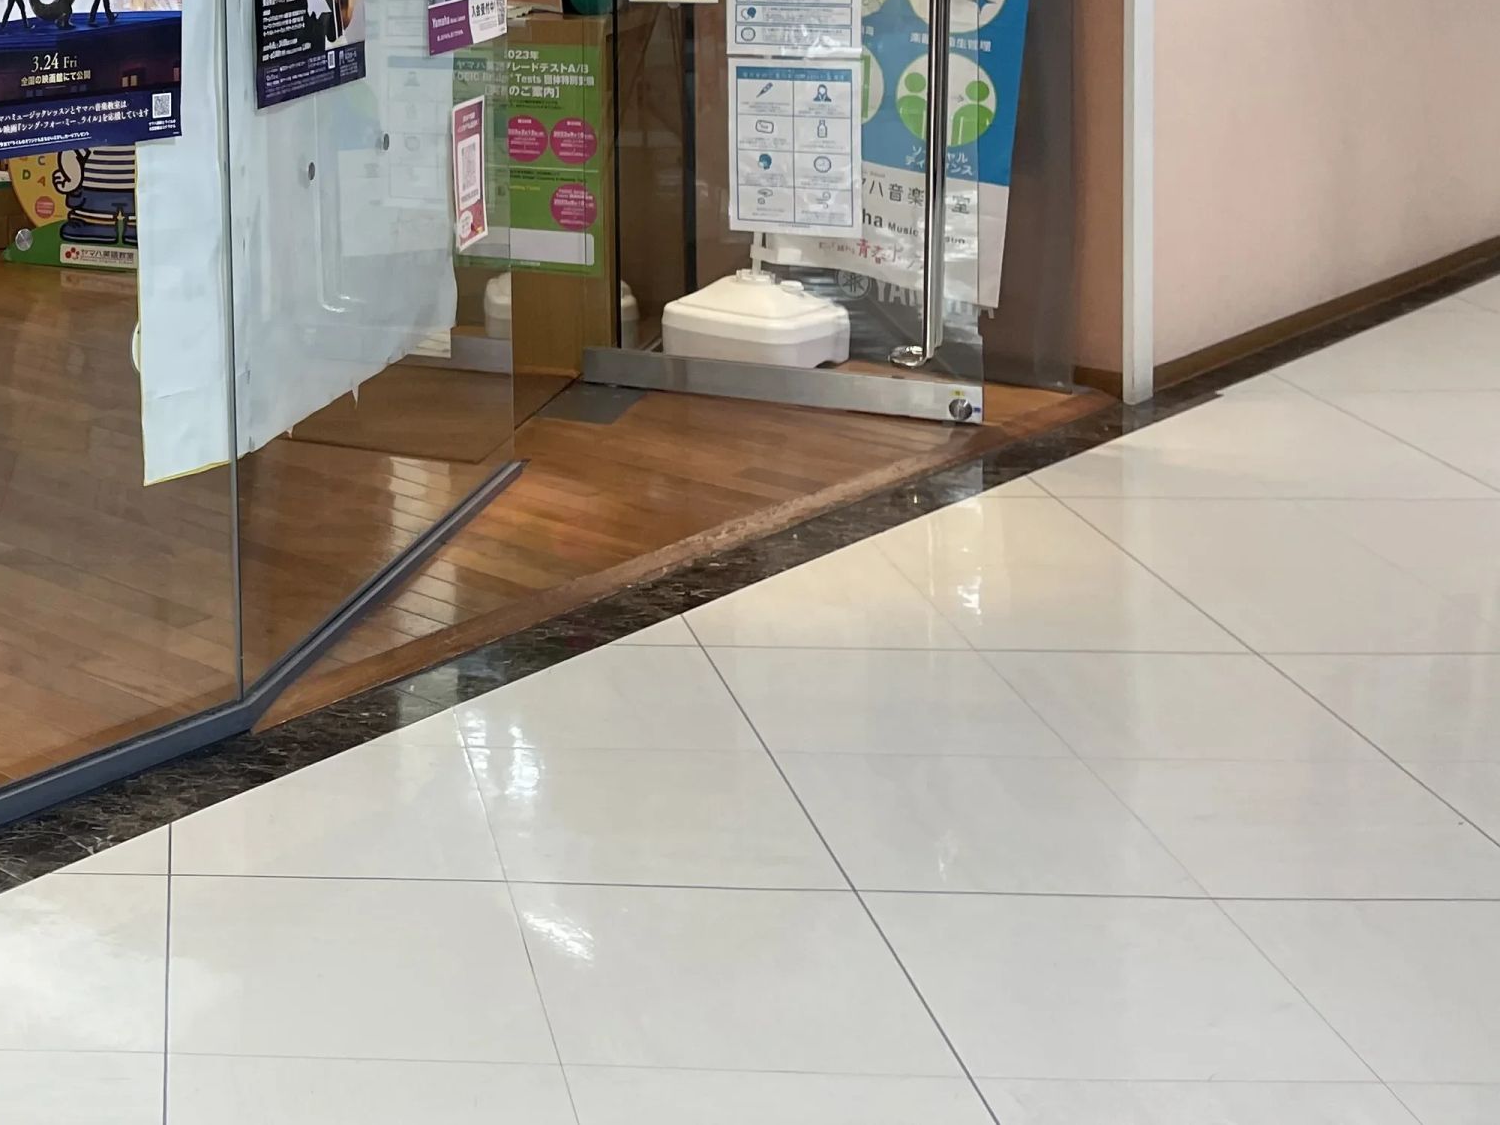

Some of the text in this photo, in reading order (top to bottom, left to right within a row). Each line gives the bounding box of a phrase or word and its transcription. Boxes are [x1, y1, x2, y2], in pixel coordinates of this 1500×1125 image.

[31, 51, 78, 73] 3.24 Fri
[887, 221, 919, 237] Music
